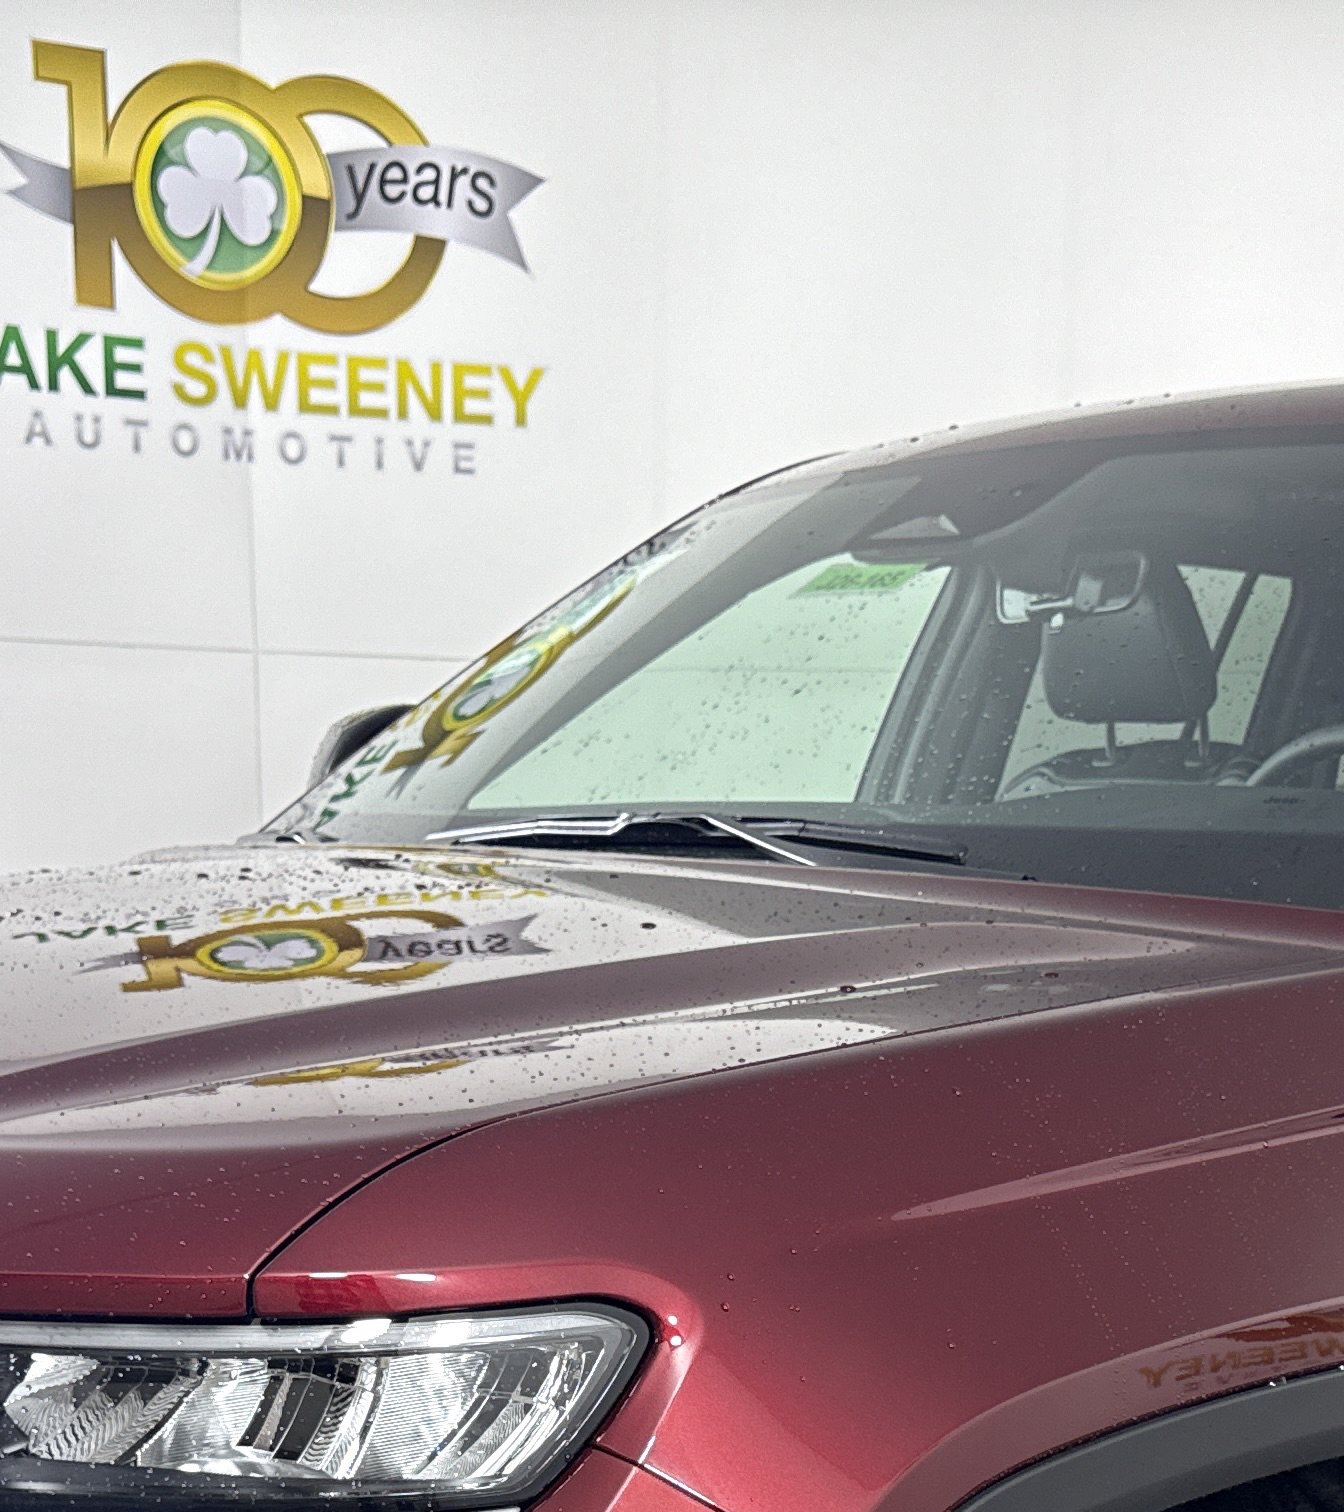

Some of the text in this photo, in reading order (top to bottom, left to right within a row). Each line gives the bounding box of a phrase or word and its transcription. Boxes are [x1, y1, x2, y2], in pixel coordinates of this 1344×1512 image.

[30, 38, 447, 336] 100
[344, 156, 498, 220] years
[171, 341, 546, 428] SWEENEY
[25, 410, 477, 475] AUTOMOTIVE
